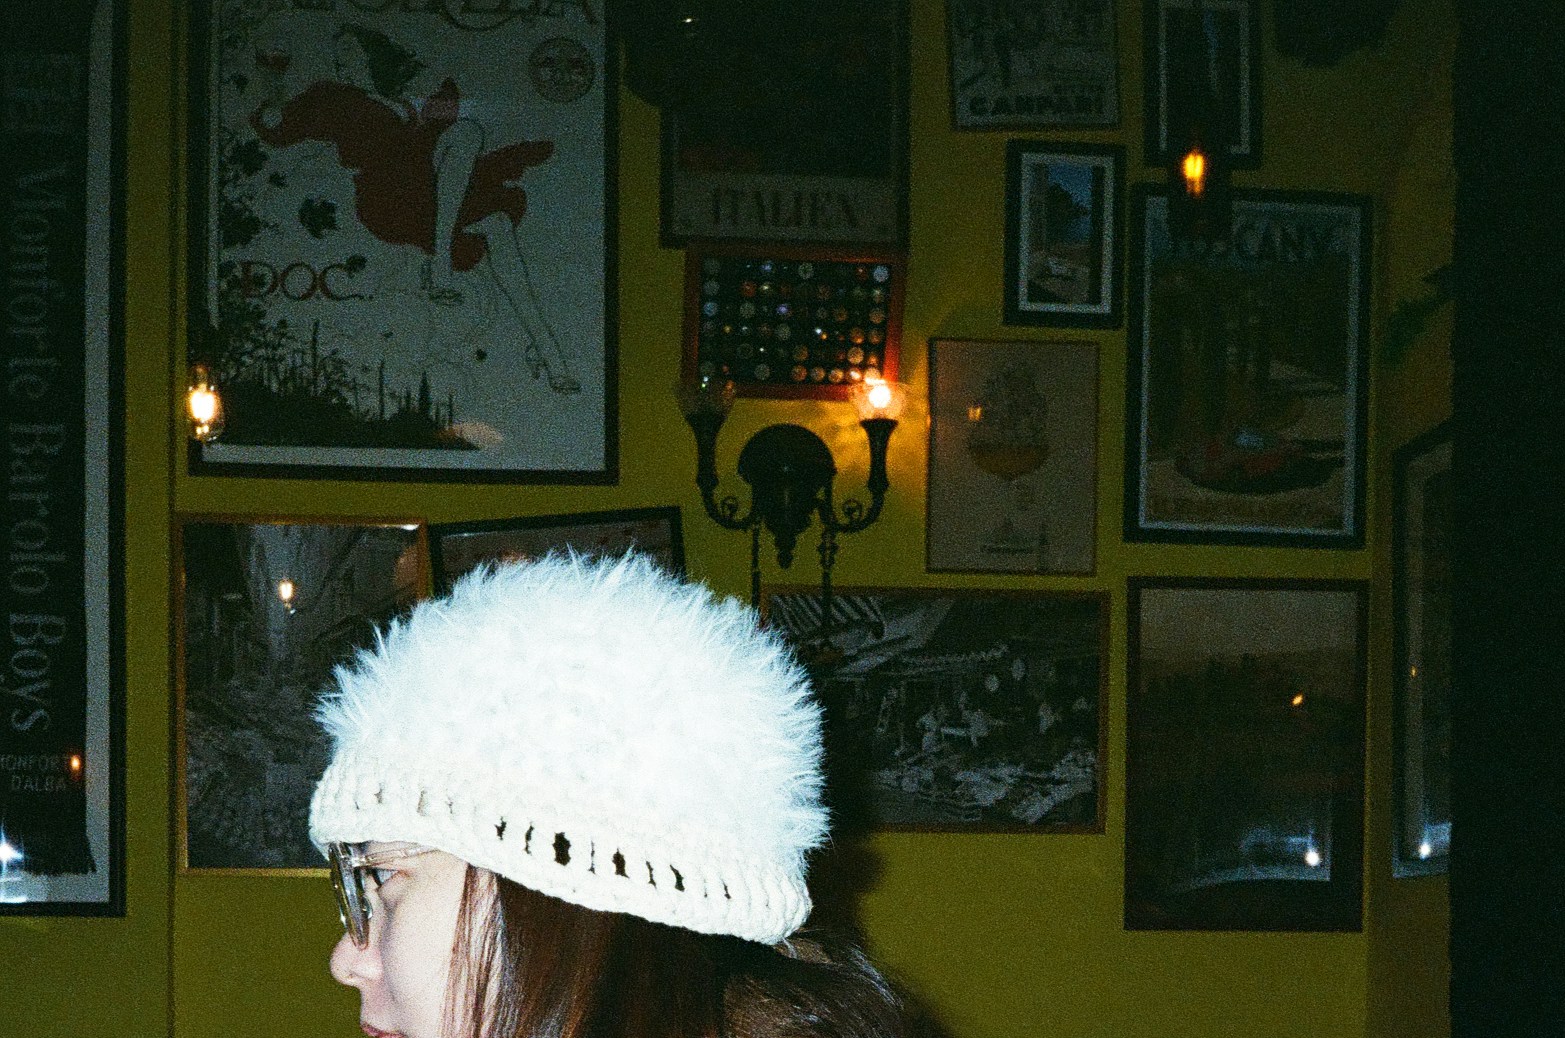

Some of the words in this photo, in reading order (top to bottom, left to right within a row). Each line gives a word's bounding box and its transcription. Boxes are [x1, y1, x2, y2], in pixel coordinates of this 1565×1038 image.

[970, 94, 1104, 116] CAMPARI
[711, 186, 859, 228] ITALIEN
[9, 422, 67, 595] Barolo
[0, 611, 67, 732] Boys
